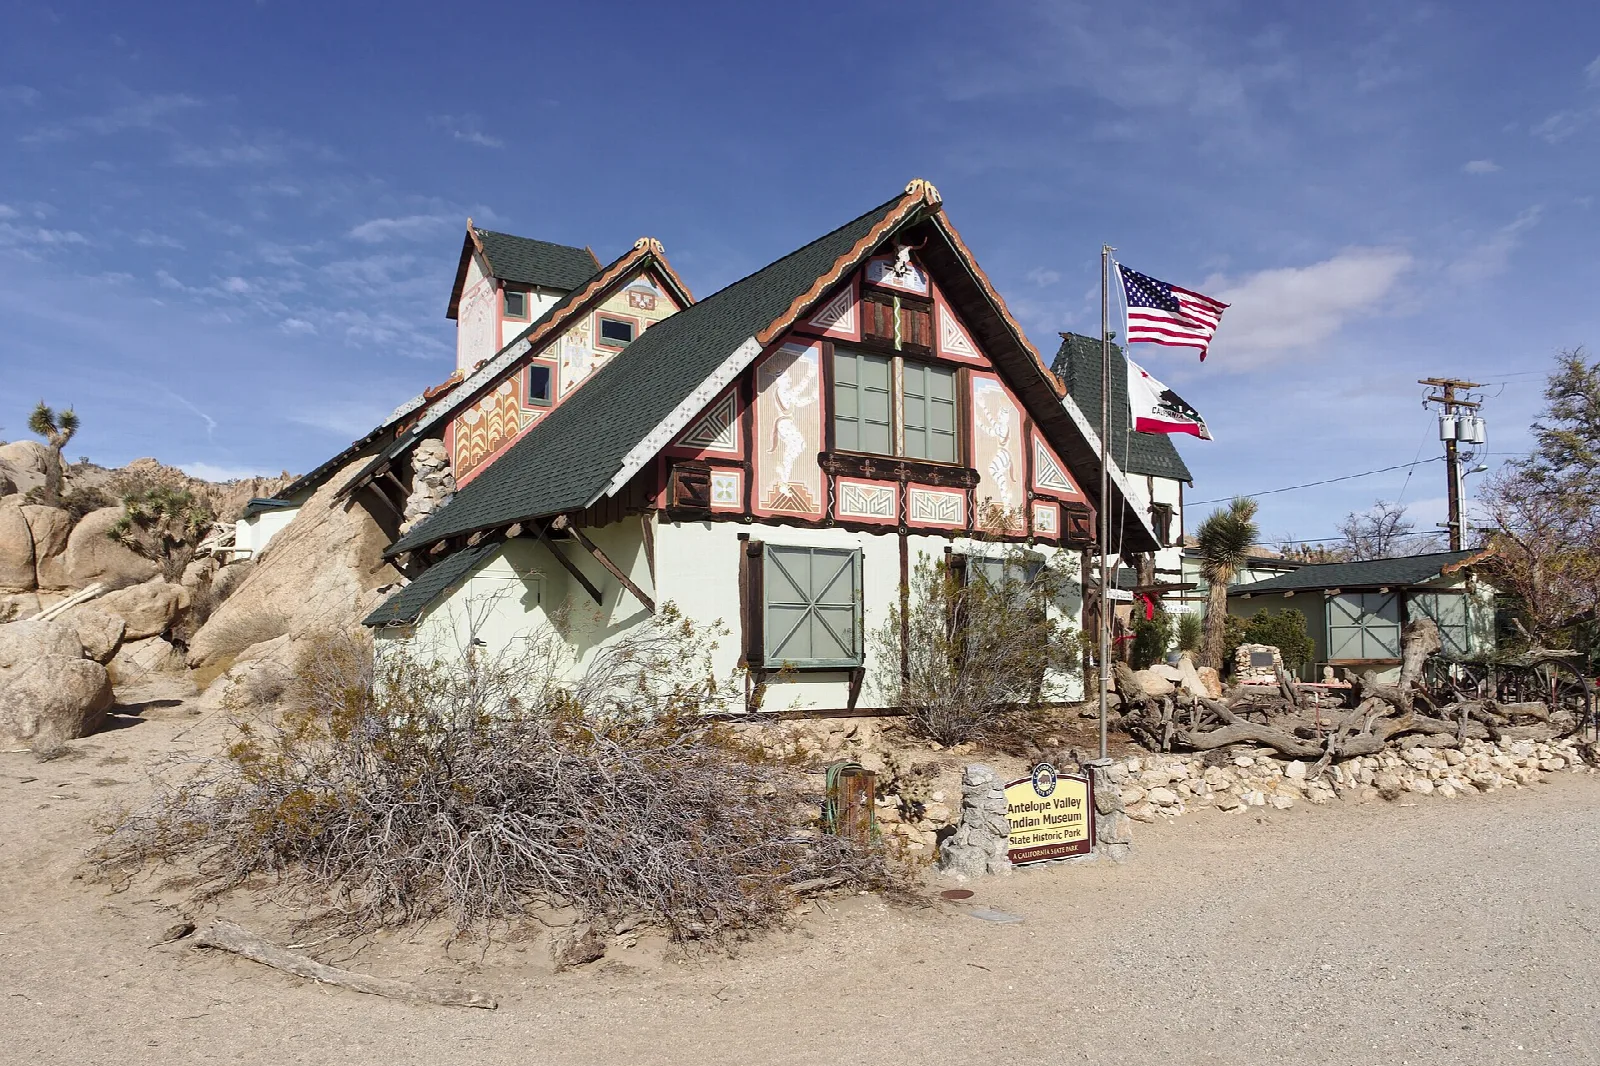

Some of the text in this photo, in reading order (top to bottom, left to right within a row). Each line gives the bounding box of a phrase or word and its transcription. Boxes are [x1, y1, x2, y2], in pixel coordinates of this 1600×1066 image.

[1007, 797, 1082, 814] Antelope Valley
[1007, 813, 1082, 829] Indian Museum
[1009, 829, 1081, 845] State Historic Park
[1017, 850, 1050, 860] CALIFORNIA
[1050, 847, 1065, 855] STATE
[1065, 844, 1079, 852] PARK
